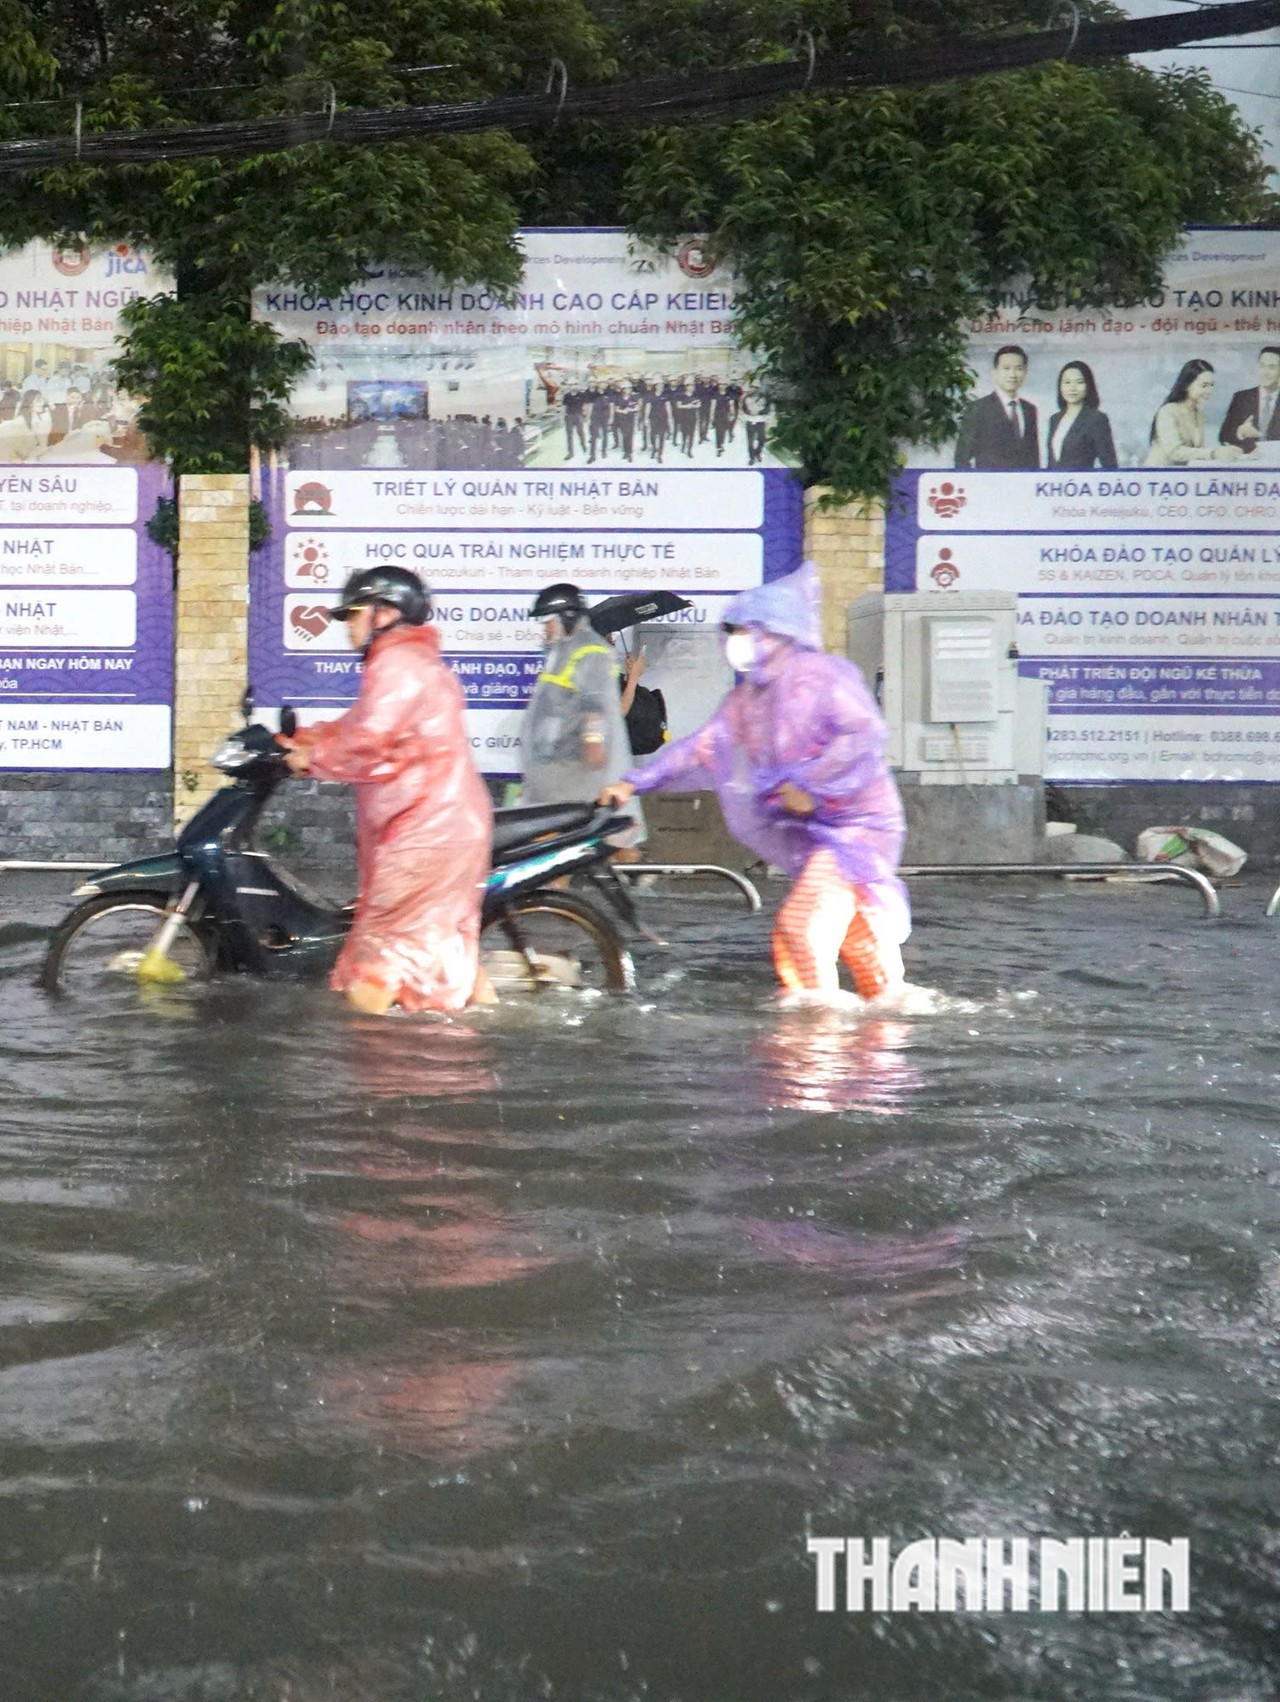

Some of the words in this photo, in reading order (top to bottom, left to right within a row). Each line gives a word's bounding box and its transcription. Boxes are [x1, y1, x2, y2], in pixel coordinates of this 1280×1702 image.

[16, 287, 79, 312] NHẬT
[340, 293, 389, 316] HỌC
[398, 293, 453, 312] KINH
[462, 293, 544, 312] DOANH
[553, 293, 602, 312] CAO
[611, 289, 658, 311] CẤP
[1173, 290, 1222, 313] TẠO
[38, 315, 76, 334] Nhật
[316, 320, 349, 335] Đào
[355, 322, 381, 336] tạo
[387, 320, 438, 335] doanh
[444, 320, 485, 335] nhân
[492, 320, 527, 335] theo
[534, 320, 560, 334] mô
[566, 319, 603, 334] hình
[608, 317, 660, 334] chuẩn
[666, 320, 704, 336] Nhật
[1022, 320, 1053, 333] cho
[1060, 318, 1096, 333] lãnh
[1103, 319, 1134, 335] đạo
[1151, 318, 1178, 335] đội
[1184, 320, 1217, 336] ngũ
[38, 475, 77, 494] SÂU
[373, 479, 427, 497] TRIẾT
[433, 479, 457, 497] LÝ
[463, 478, 517, 497] QUẢN
[524, 482, 554, 500] TRỊ
[560, 478, 612, 500] NHẬT
[619, 479, 659, 497] BẢN
[1036, 479, 1093, 497] KHÓA
[1097, 479, 1141, 497] ĐÀO
[1147, 482, 1188, 500] TẠO
[1195, 479, 1248, 497] LÃNH
[4, 538, 56, 559] NHẬT
[366, 543, 407, 562] HỌC
[413, 544, 455, 559] QUA
[460, 540, 504, 559] TRẢI
[510, 541, 585, 562] NGHIỆM
[592, 543, 646, 562] THỰC
[652, 539, 676, 559] TẾ
[1040, 544, 1097, 563] KHÓA
[1102, 544, 1146, 563] ĐÀO
[1153, 547, 1193, 566] TẠO
[1200, 544, 1256, 563] QUẢN
[6, 601, 57, 621] NHẬT
[1040, 609, 1082, 626] ĐÀO
[1090, 612, 1129, 629] TẠO
[1136, 612, 1205, 626] DOANH
[1213, 608, 1267, 626] NHÂN
[26, 658, 66, 670] NGAY
[69, 655, 101, 670] HÔM
[104, 658, 134, 670] NAY
[315, 662, 352, 674] THAY
[1039, 667, 1080, 680] PHÁT
[1084, 666, 1126, 680] TRIỂN
[1129, 666, 1156, 683] ĐỘI
[1160, 666, 1191, 680] NGŨ
[1196, 666, 1218, 680] KẾ
[1222, 667, 1262, 680] THỪA
[481, 683, 520, 697] giảng
[1080, 687, 1115, 702] hàng
[7, 720, 39, 731] NAM
[51, 718, 90, 735] NHẬT
[94, 717, 123, 732] BẢN
[12, 740, 63, 751] TP.HCM
[486, 734, 522, 749] GIỮA
